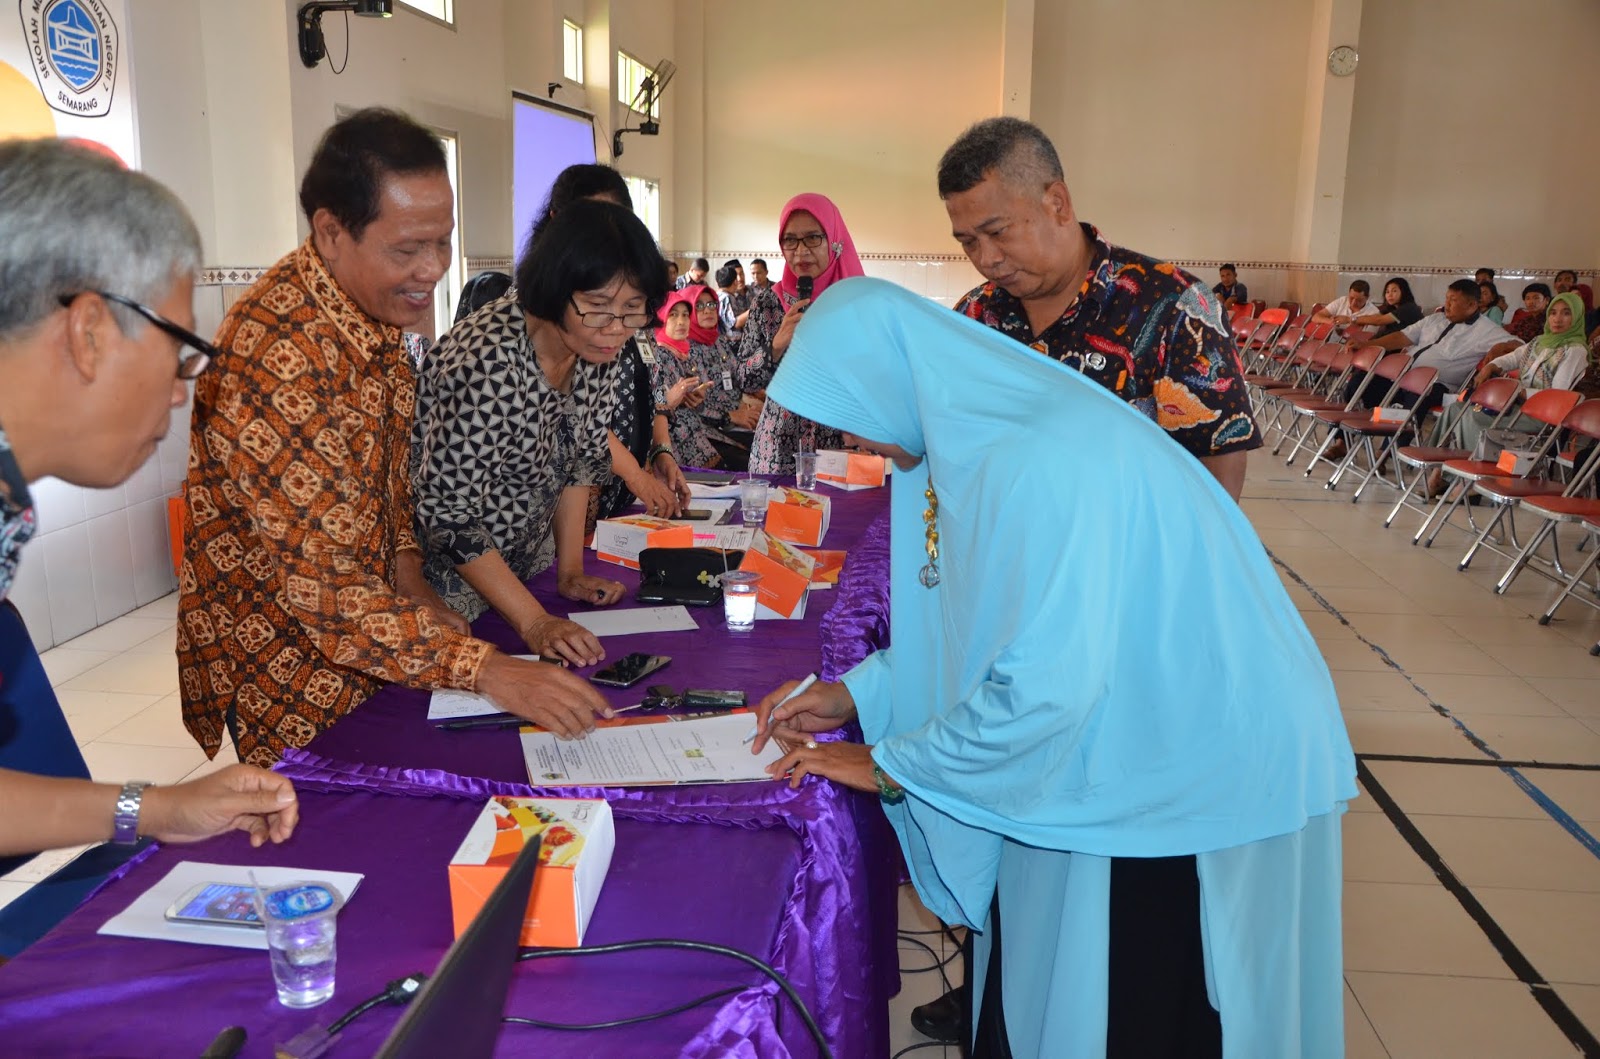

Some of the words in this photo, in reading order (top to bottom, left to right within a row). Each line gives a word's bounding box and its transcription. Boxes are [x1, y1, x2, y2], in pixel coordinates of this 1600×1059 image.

[31, 18, 50, 79] SEKOLAH
[104, 35, 113, 80] NEGERI
[58, 91, 98, 112] SEMARANG
[102, 82, 109, 92] 7
